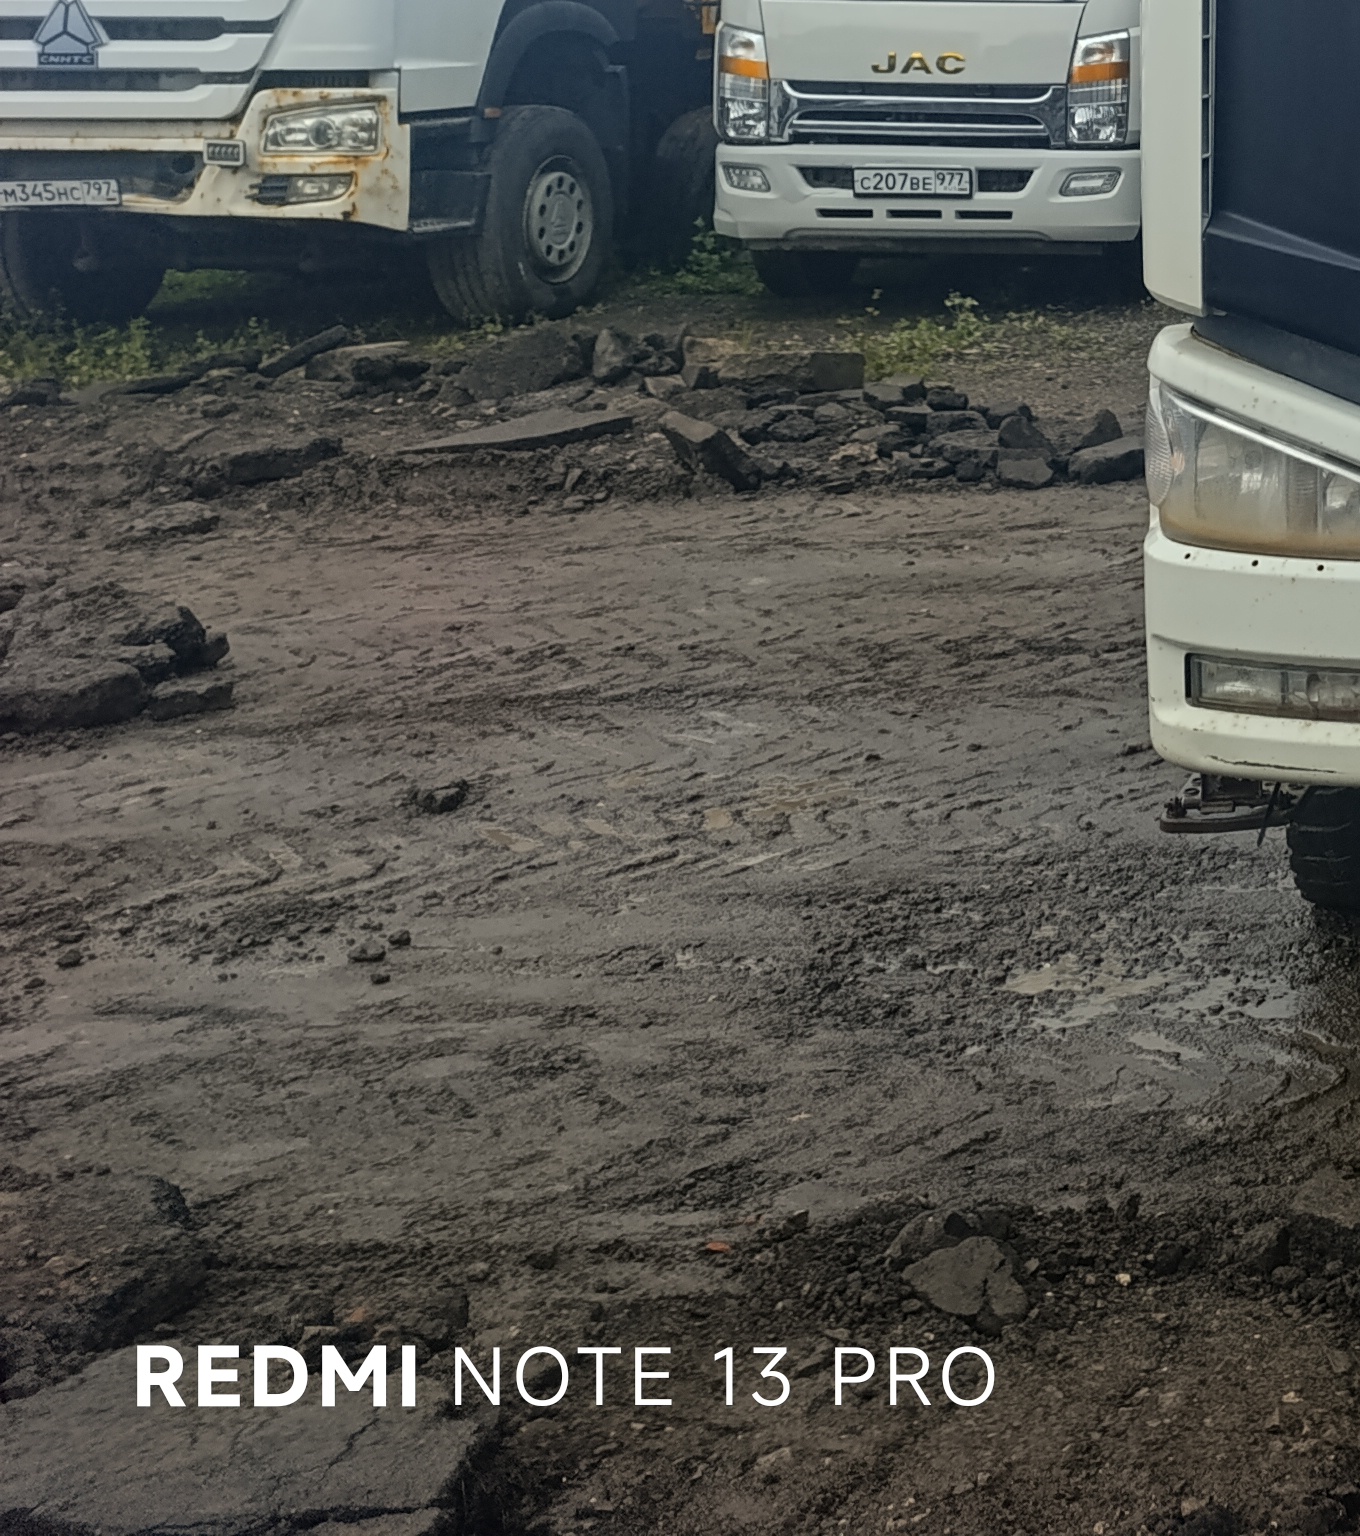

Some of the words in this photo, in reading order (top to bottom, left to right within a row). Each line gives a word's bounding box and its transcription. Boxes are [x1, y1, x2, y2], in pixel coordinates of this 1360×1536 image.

[40, 54, 93, 64] CNHTC
[871, 51, 966, 75] JAC
[936, 172, 964, 187] 977
